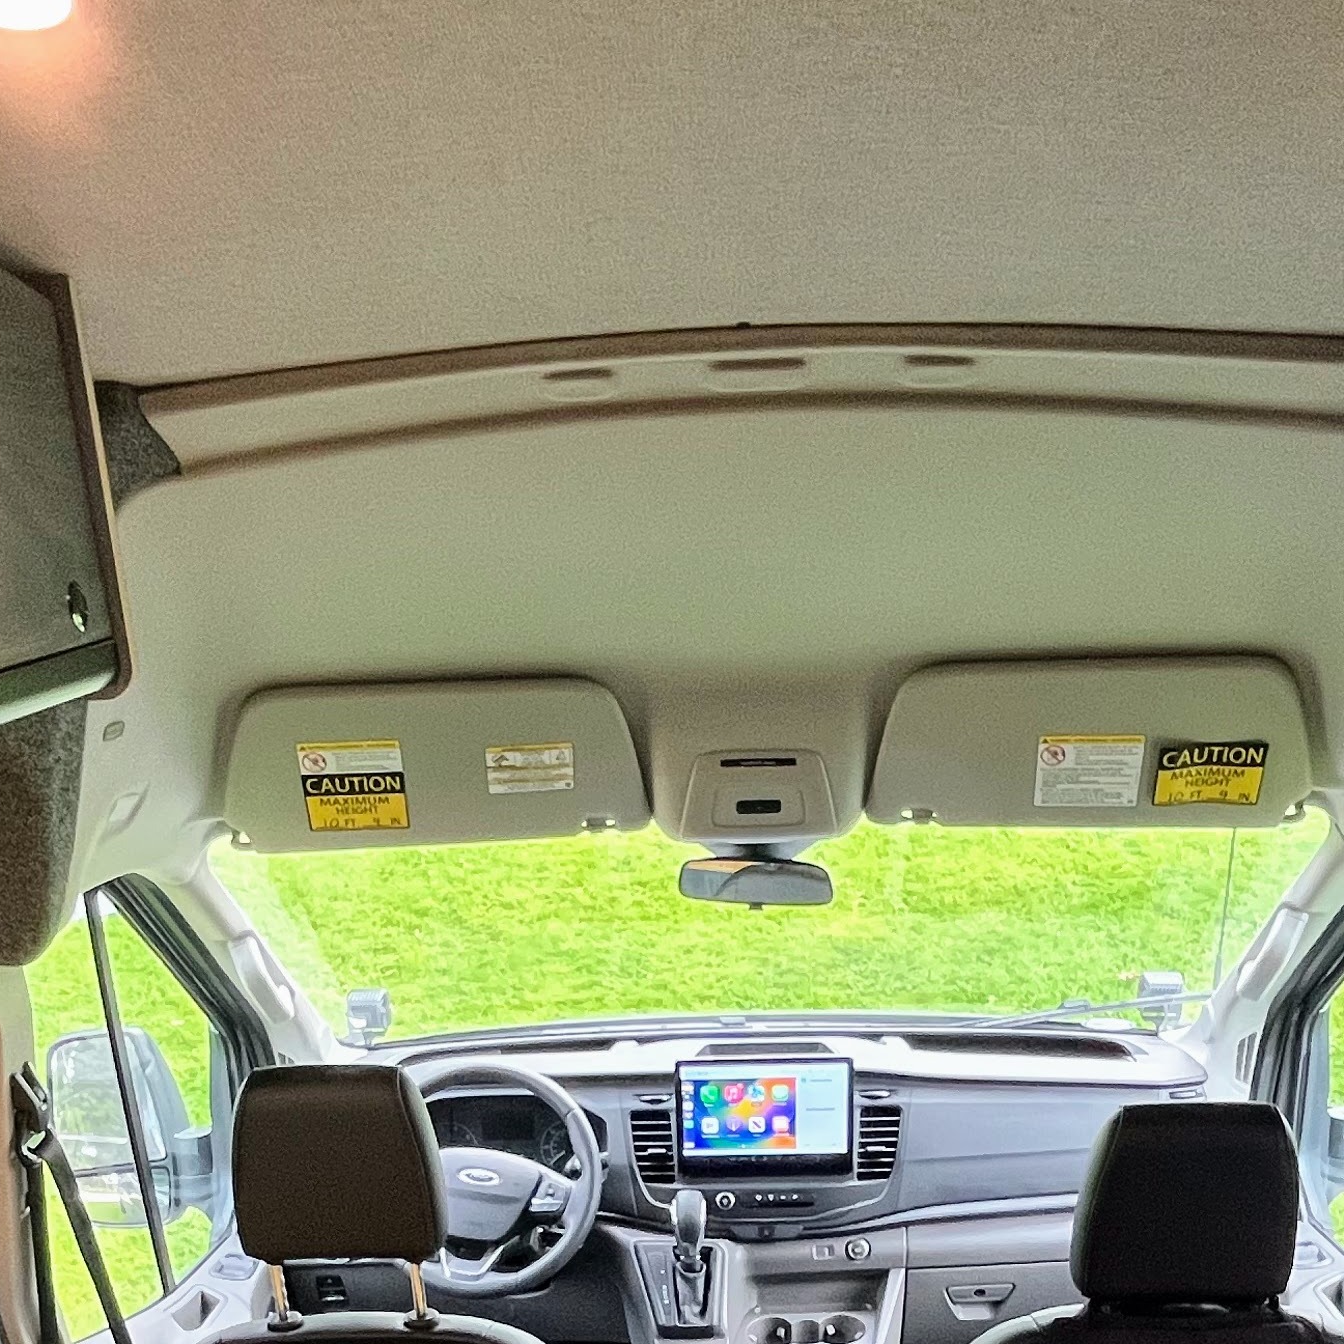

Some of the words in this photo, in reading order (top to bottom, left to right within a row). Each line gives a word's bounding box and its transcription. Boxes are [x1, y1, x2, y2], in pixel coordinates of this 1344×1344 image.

[1162, 746, 1264, 767] CAUTION
[1170, 767, 1246, 780] MAXIMUM
[305, 776, 401, 793] CAUTION
[1185, 776, 1232, 787] HEIGHT
[320, 796, 390, 806] MAXIMUM
[337, 806, 378, 815] HEIGHT
